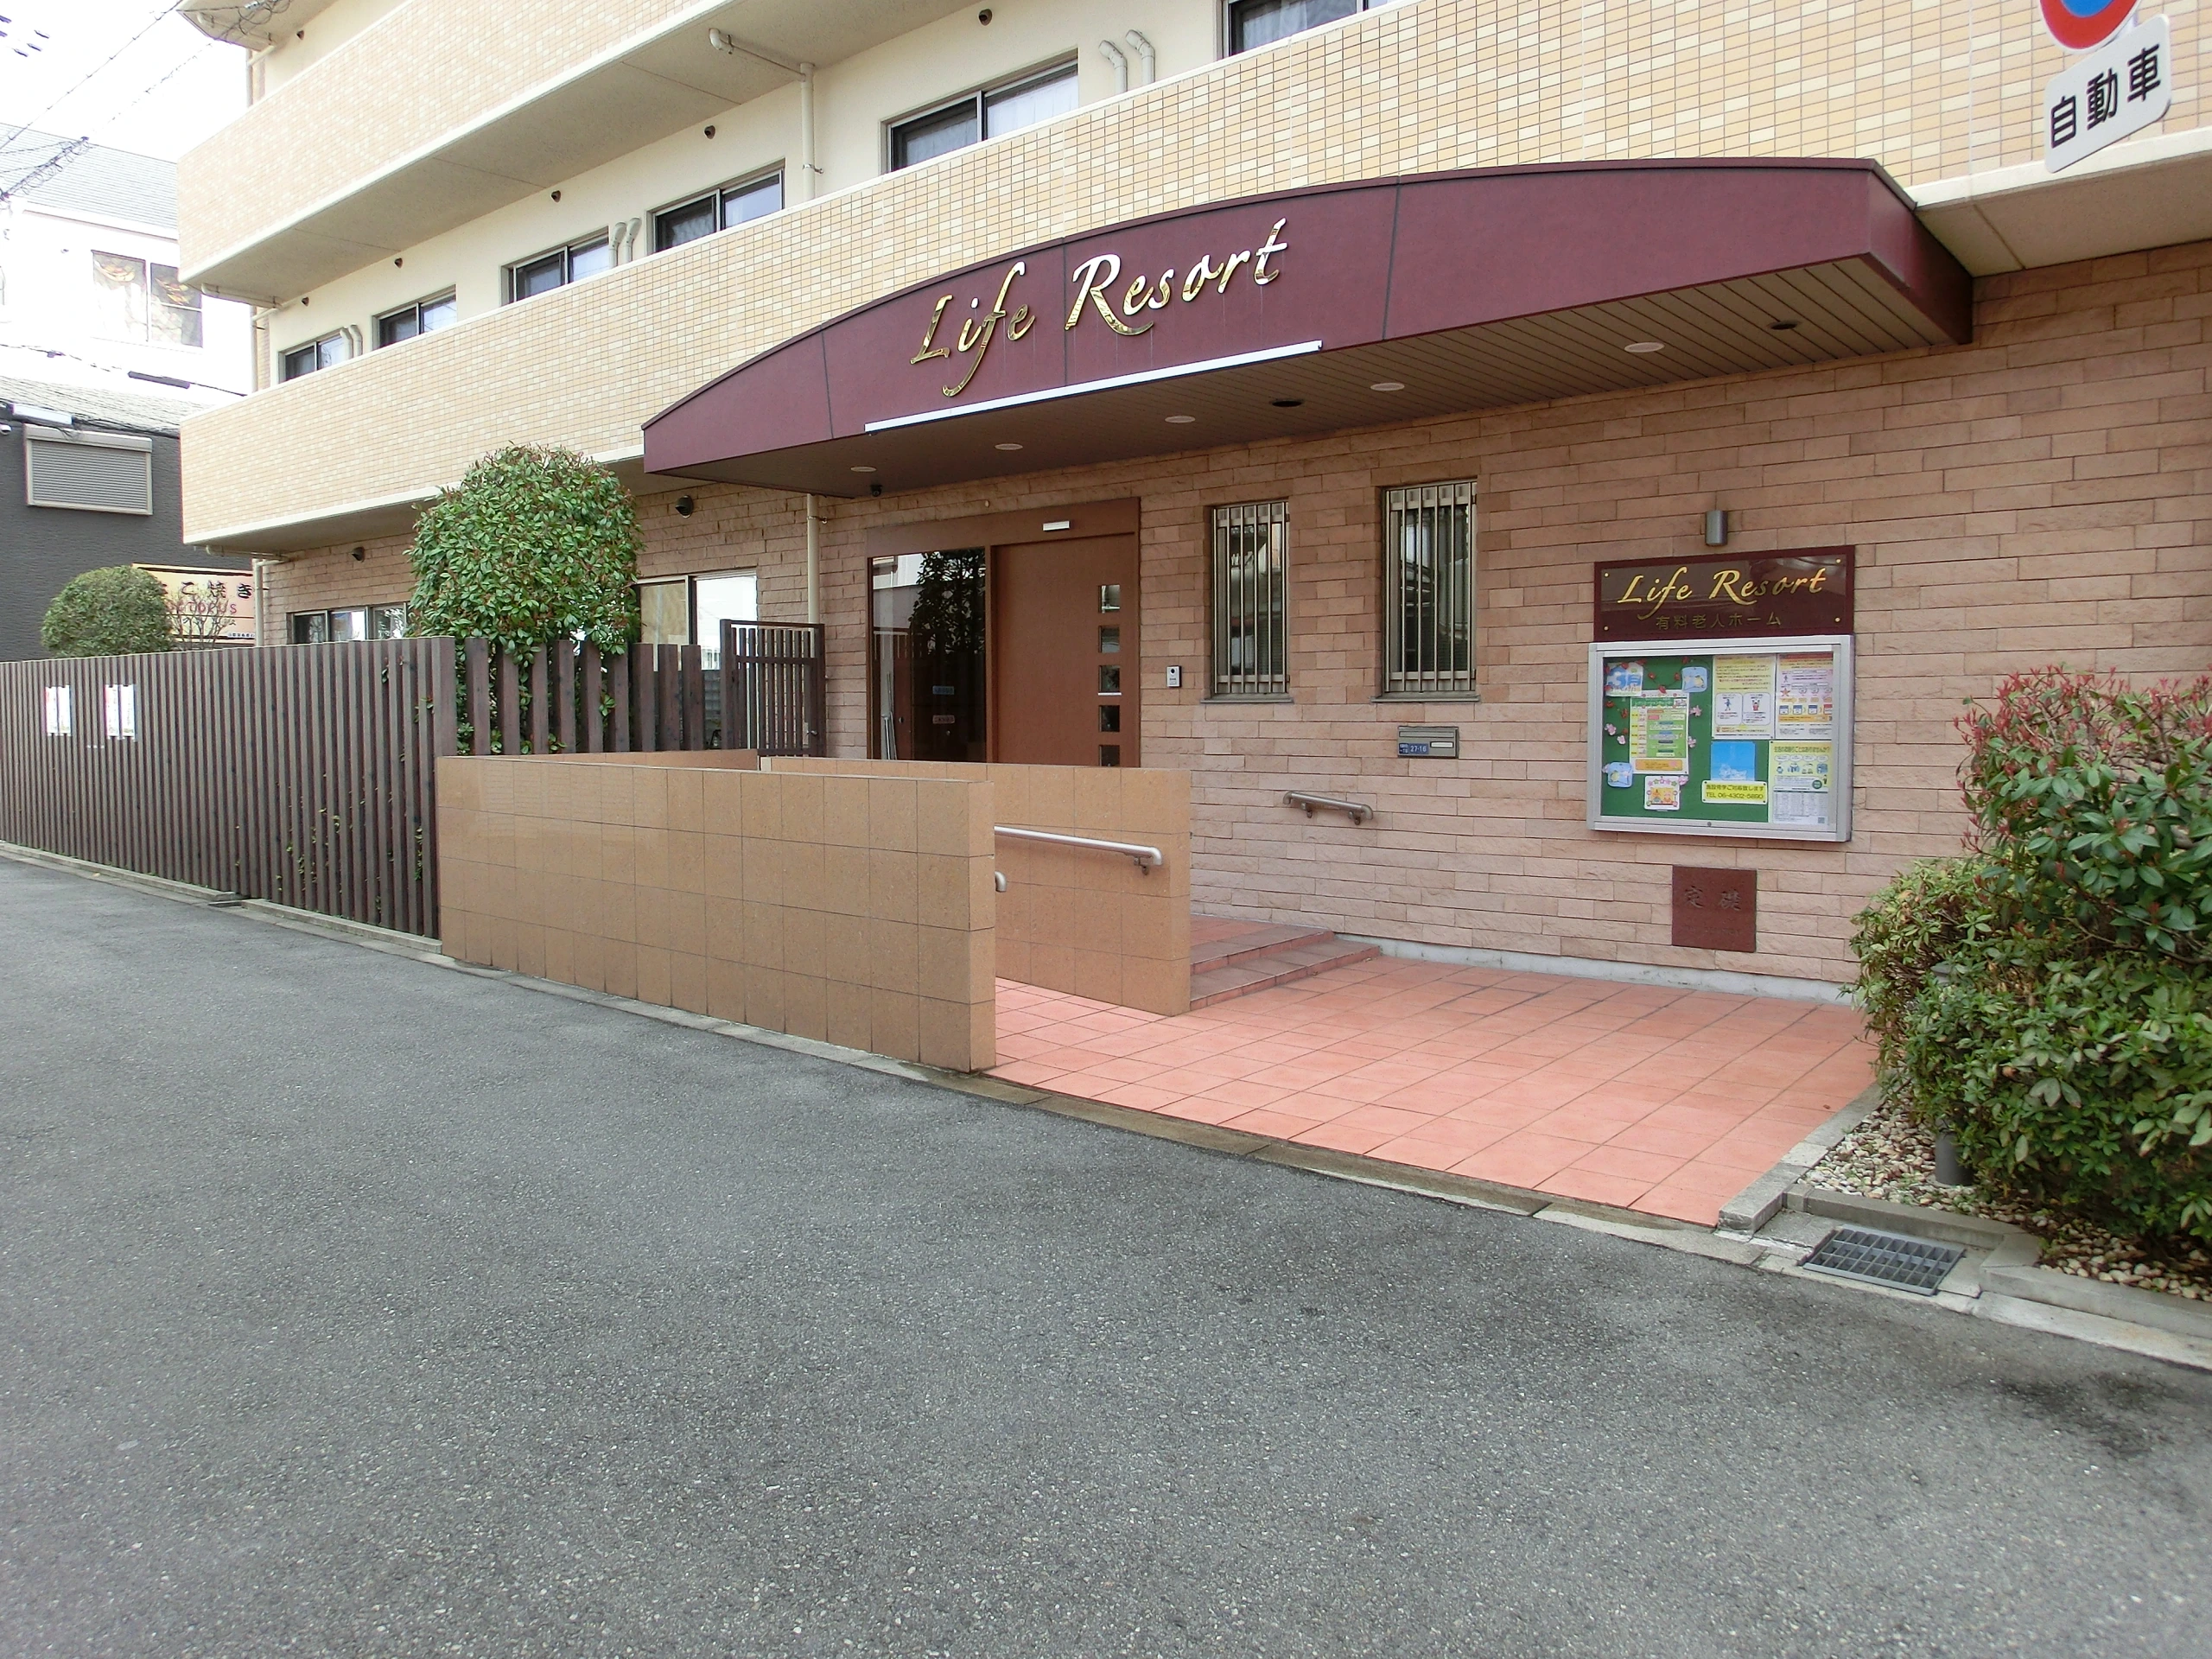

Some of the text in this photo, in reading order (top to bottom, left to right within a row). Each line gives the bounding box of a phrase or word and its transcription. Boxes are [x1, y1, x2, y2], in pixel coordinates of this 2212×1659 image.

[2050, 43, 2161, 149] 自動車
[910, 218, 1288, 397] Life Resort
[162, 580, 253, 599] こ焼き
[1617, 566, 1827, 620] Life Resort
[1656, 611, 1782, 631] 有料老人ホーム
